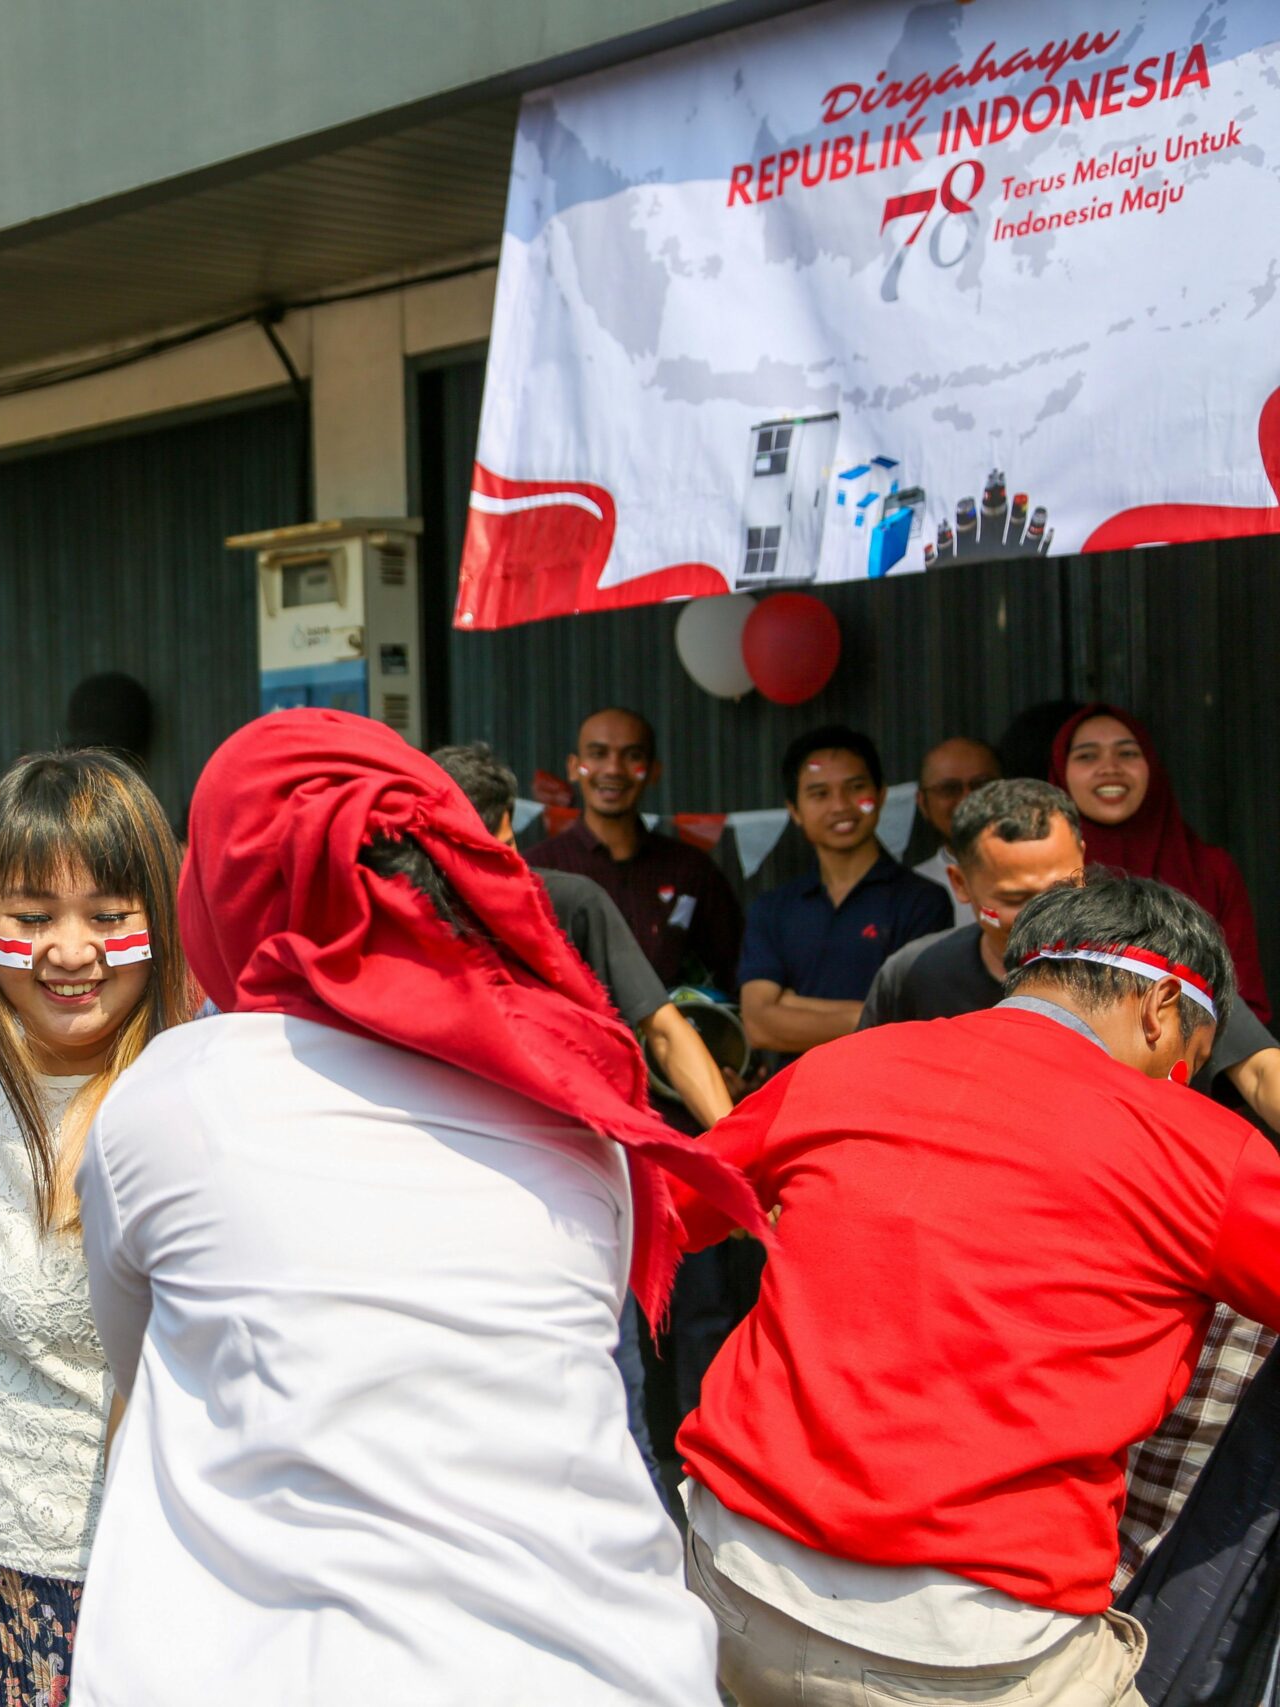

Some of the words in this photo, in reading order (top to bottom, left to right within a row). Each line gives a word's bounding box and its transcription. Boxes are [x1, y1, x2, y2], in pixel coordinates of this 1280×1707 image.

[822, 29, 1120, 124] Dirgahayu
[726, 115, 928, 208] REPUBLIK
[937, 43, 1211, 156] INDONESIA
[1001, 172, 1066, 201] Terus
[1073, 146, 1157, 186] Melaju
[1165, 120, 1242, 163] Untuk
[880, 159, 986, 303] 78
[993, 197, 1113, 241] Indonesia
[1120, 179, 1185, 215] Maju
